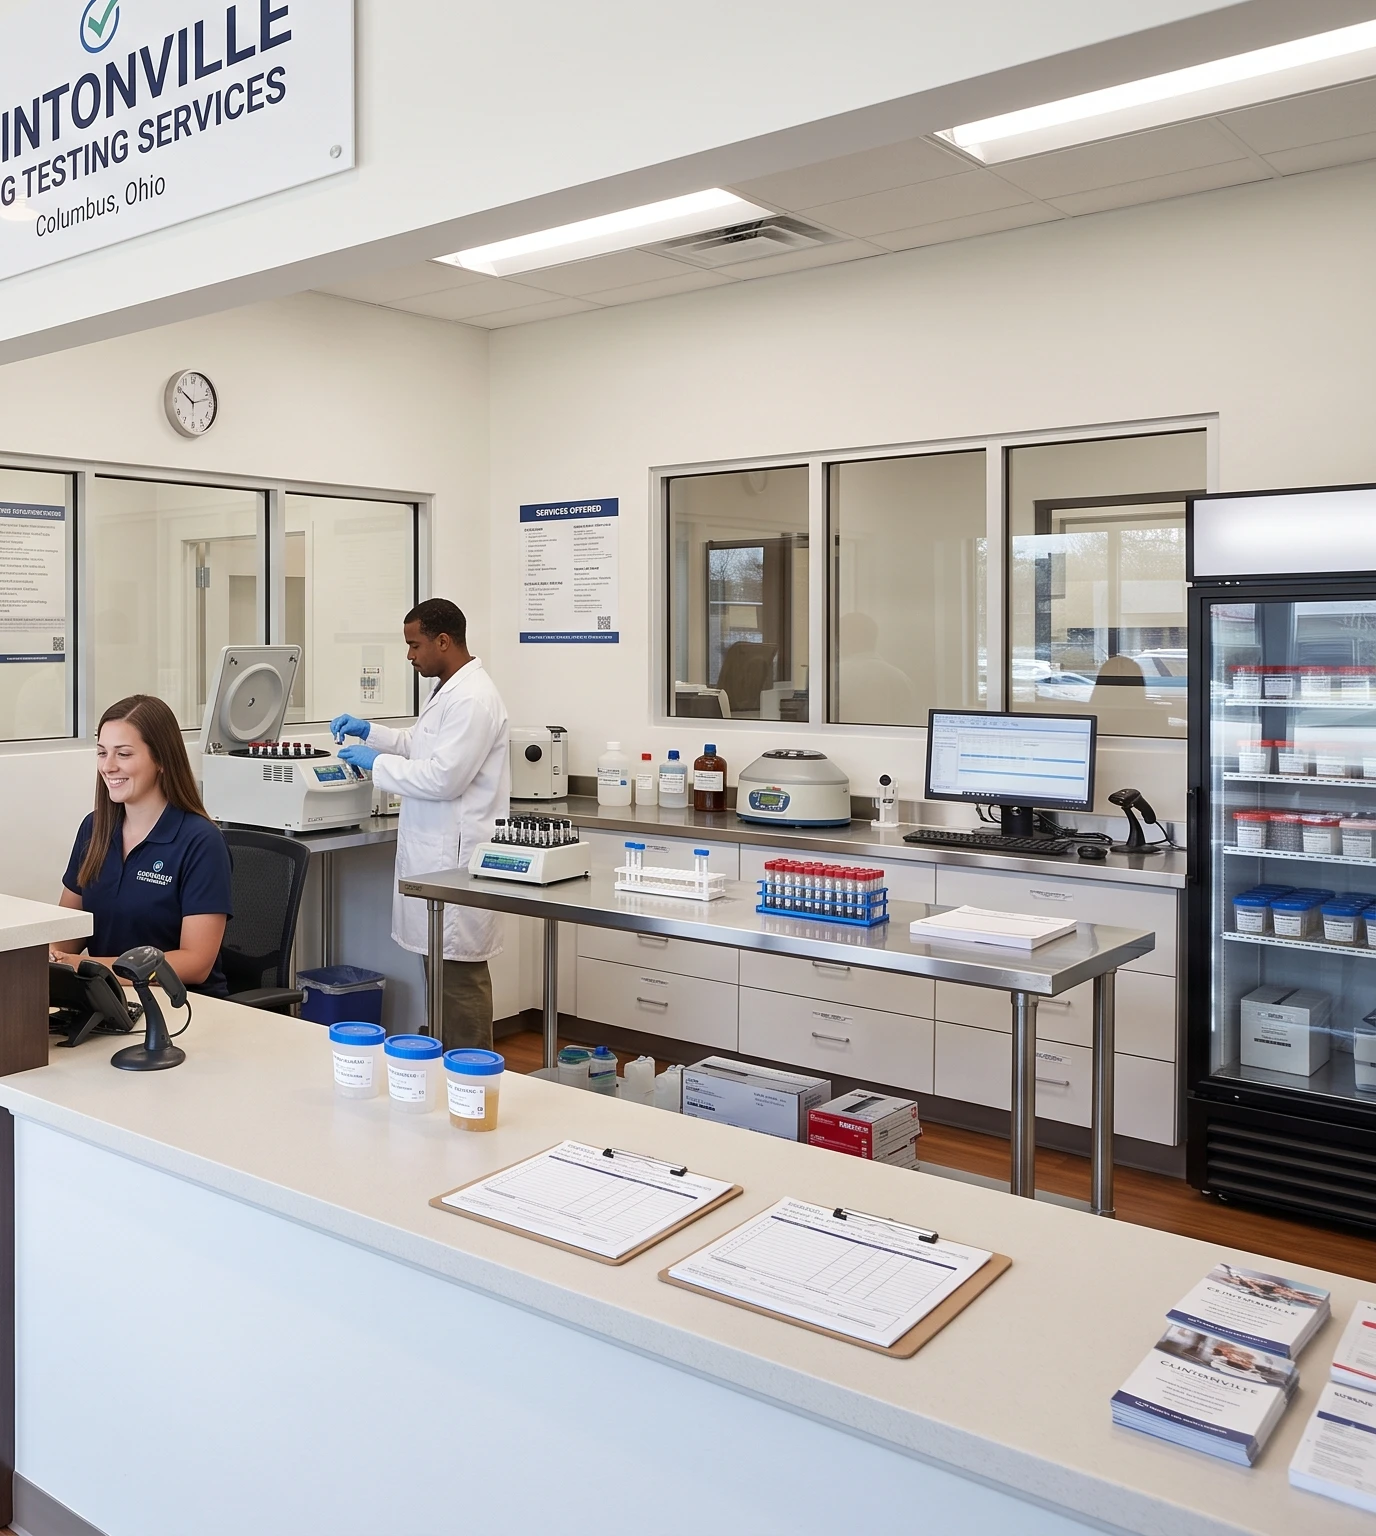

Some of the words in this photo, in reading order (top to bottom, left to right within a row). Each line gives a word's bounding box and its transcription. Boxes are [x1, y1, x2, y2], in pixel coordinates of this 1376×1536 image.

[21, 129, 129, 198] TESTING
[137, 66, 287, 154] SERVICES
[36, 190, 121, 237] Columbus,
[125, 176, 166, 206] Ohio
[536, 507, 568, 517] SERVICES
[569, 505, 602, 515] OFFERED
